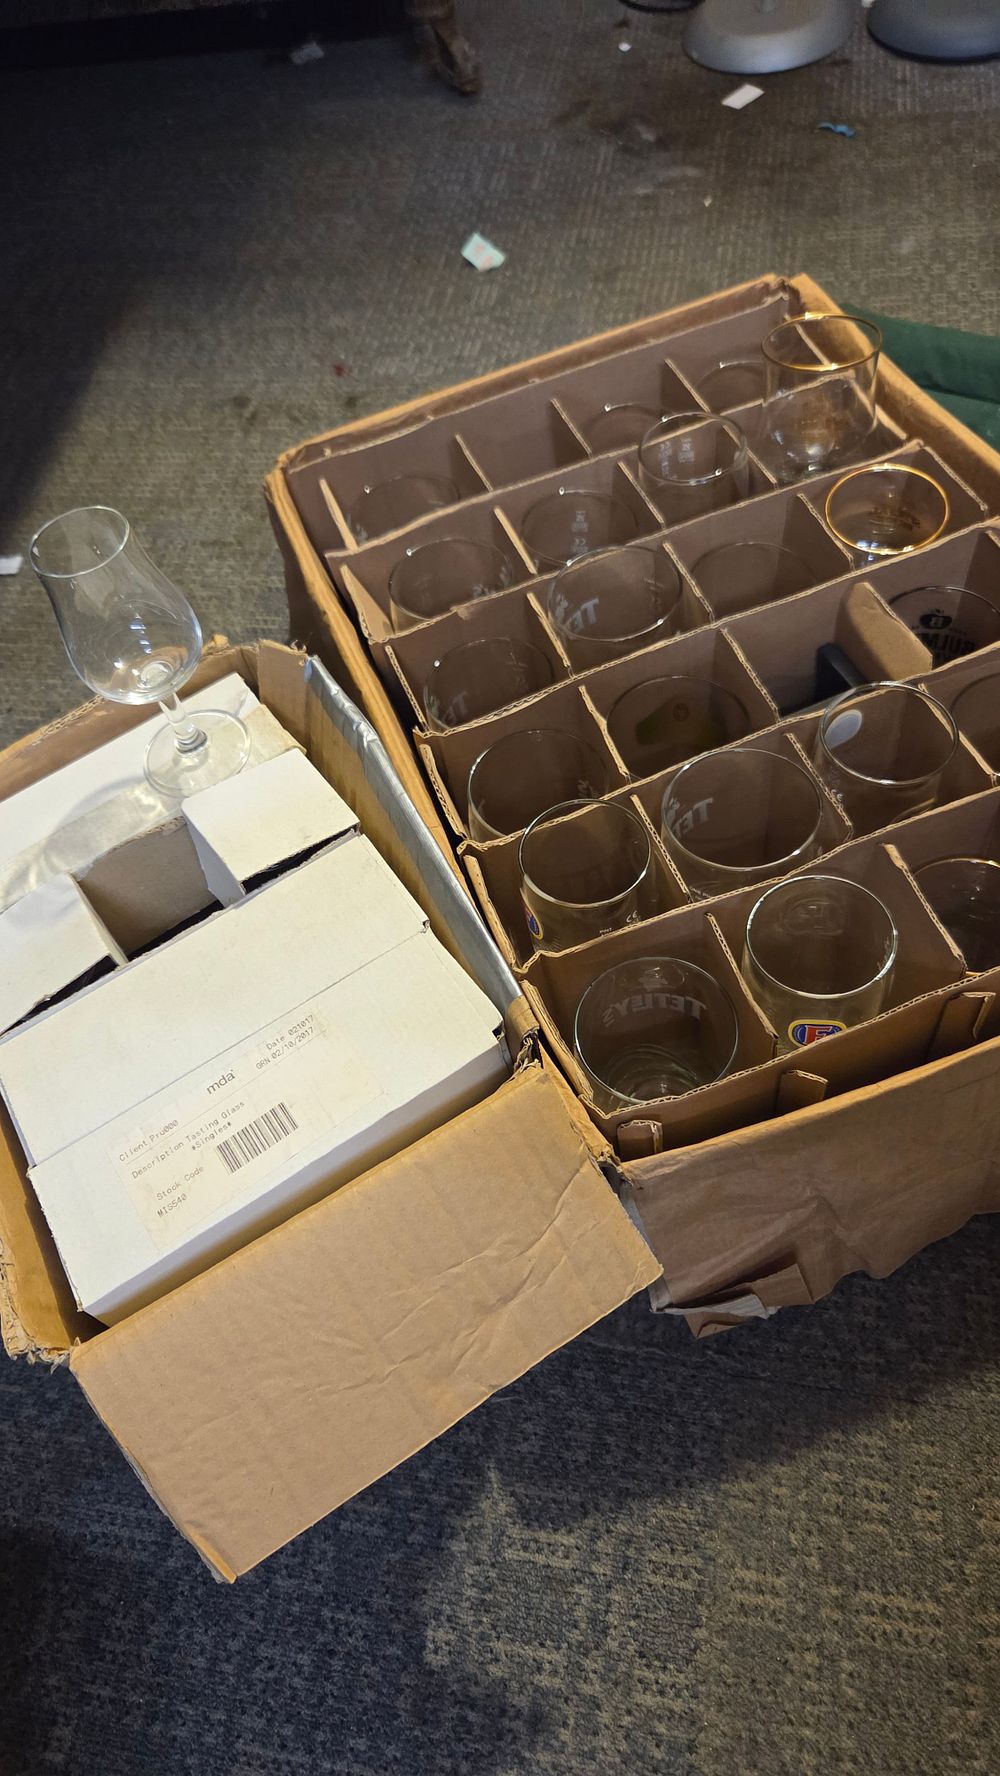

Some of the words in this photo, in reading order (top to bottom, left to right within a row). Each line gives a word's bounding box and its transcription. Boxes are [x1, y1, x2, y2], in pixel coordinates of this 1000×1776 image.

[266, 1036, 285, 1050] Date
[287, 1014, 314, 1036] 021017
[271, 1026, 314, 1059] 02/10/2017
[119, 1140, 148, 1162] Client
[131, 1141, 185, 1179] Description
[185, 1119, 219, 1143] Tasting
[221, 1102, 245, 1119] Glass
[156, 1181, 181, 1201] Stock
[184, 1166, 204, 1182] Code
